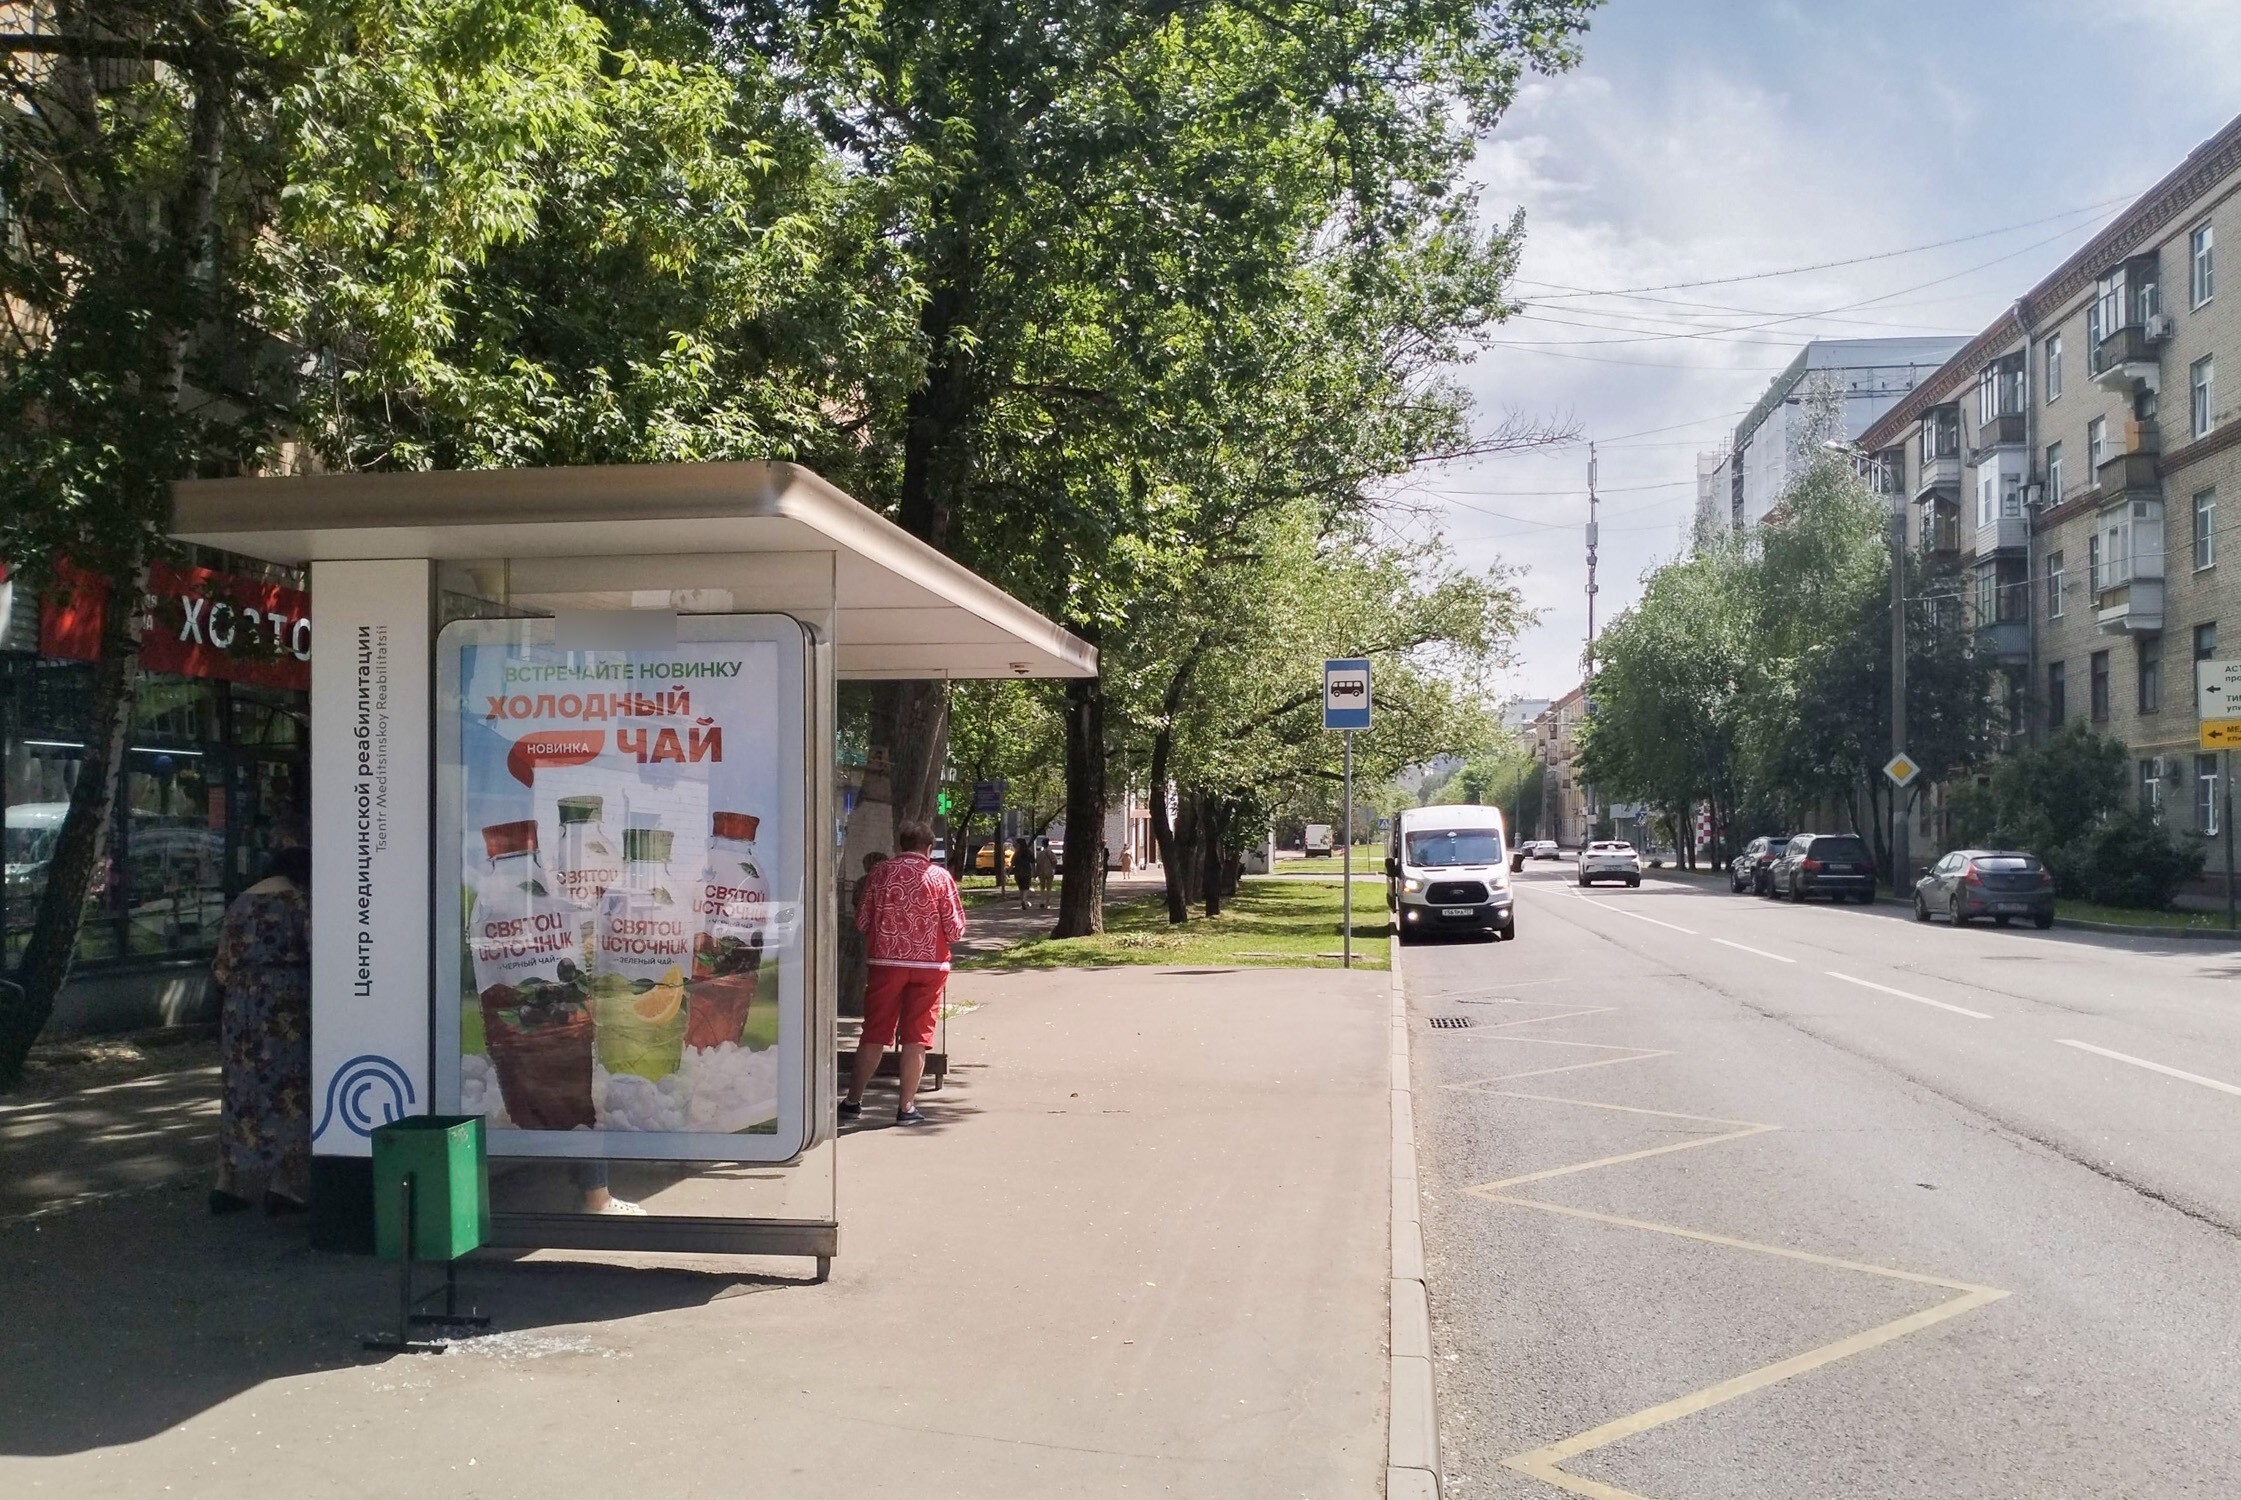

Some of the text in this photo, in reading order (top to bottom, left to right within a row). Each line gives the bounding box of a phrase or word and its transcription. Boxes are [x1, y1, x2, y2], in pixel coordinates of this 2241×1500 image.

[505, 661, 743, 682] ВСТРЕЧАЙТЕ НОВИНКУ
[486, 684, 690, 721] ХОЛОДНЫЙ
[375, 625, 390, 853] Tsentr Meditsinskoy Reabilitatsii
[527, 743, 590, 754] НОВИНКА
[617, 716, 722, 763] ЧАЙ
[353, 625, 374, 998] Центр медицинской реабилитации
[601, 935, 688, 955] ИСТОЧНИК
[502, 954, 556, 970] ЧЕРНЫЙ ЧАЙ
[657, 956, 672, 965] ЧАЙ
